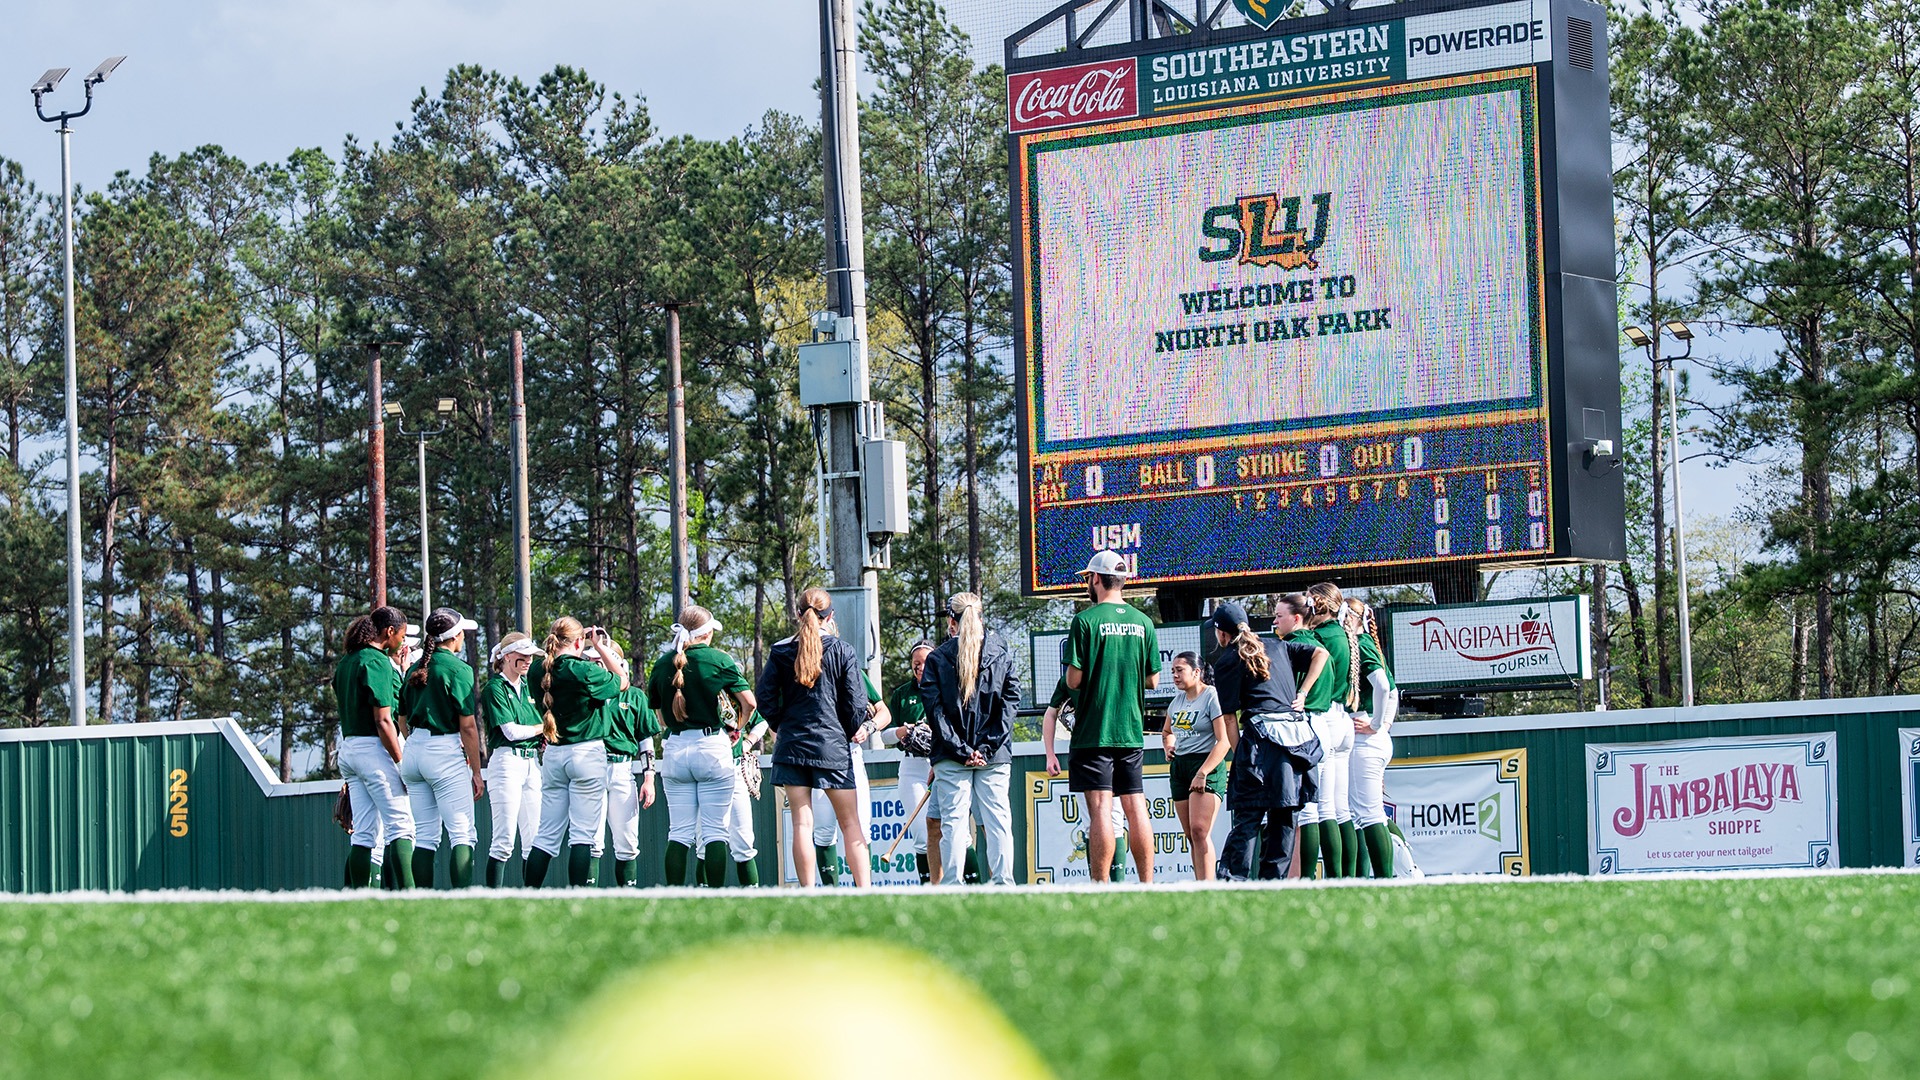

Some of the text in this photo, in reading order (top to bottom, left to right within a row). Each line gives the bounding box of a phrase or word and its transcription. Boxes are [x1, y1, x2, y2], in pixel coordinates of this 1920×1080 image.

[1408, 21, 1543, 57] POWERADE
[1152, 25, 1390, 82] SOUTHEASTERN
[1152, 56, 1390, 104] LOUISIANA UNIVERSITY
[1015, 66, 1132, 123] Coca-Cola
[1180, 275, 1356, 316] WELCOME TO
[1155, 308, 1391, 353] NORTH OAK PARK
[1237, 450, 1307, 478] STRIKE
[1353, 441, 1395, 468] OUT
[1043, 462, 1062, 482] AT
[1140, 461, 1188, 487] BALL
[1255, 491, 1267, 510] 2
[1092, 523, 1141, 551] USM
[1099, 622, 1145, 639] CHAMPIONS
[1490, 654, 1549, 675] TOURISM
[1506, 759, 1519, 773] S
[1658, 765, 1680, 777] THE
[1034, 780, 1044, 793] S
[170, 768, 188, 837] 225
[1613, 763, 1801, 837] JAMBALAYA
[1411, 803, 1476, 828] HOME
[1708, 819, 1761, 835] SHOPPE
[1451, 828, 1477, 836] HILTON
[1647, 849, 1660, 859] Let
[1673, 849, 1694, 858] cater
[1696, 849, 1716, 860] your
[1717, 848, 1736, 857] next
[1738, 845, 1773, 858] tailgate!
